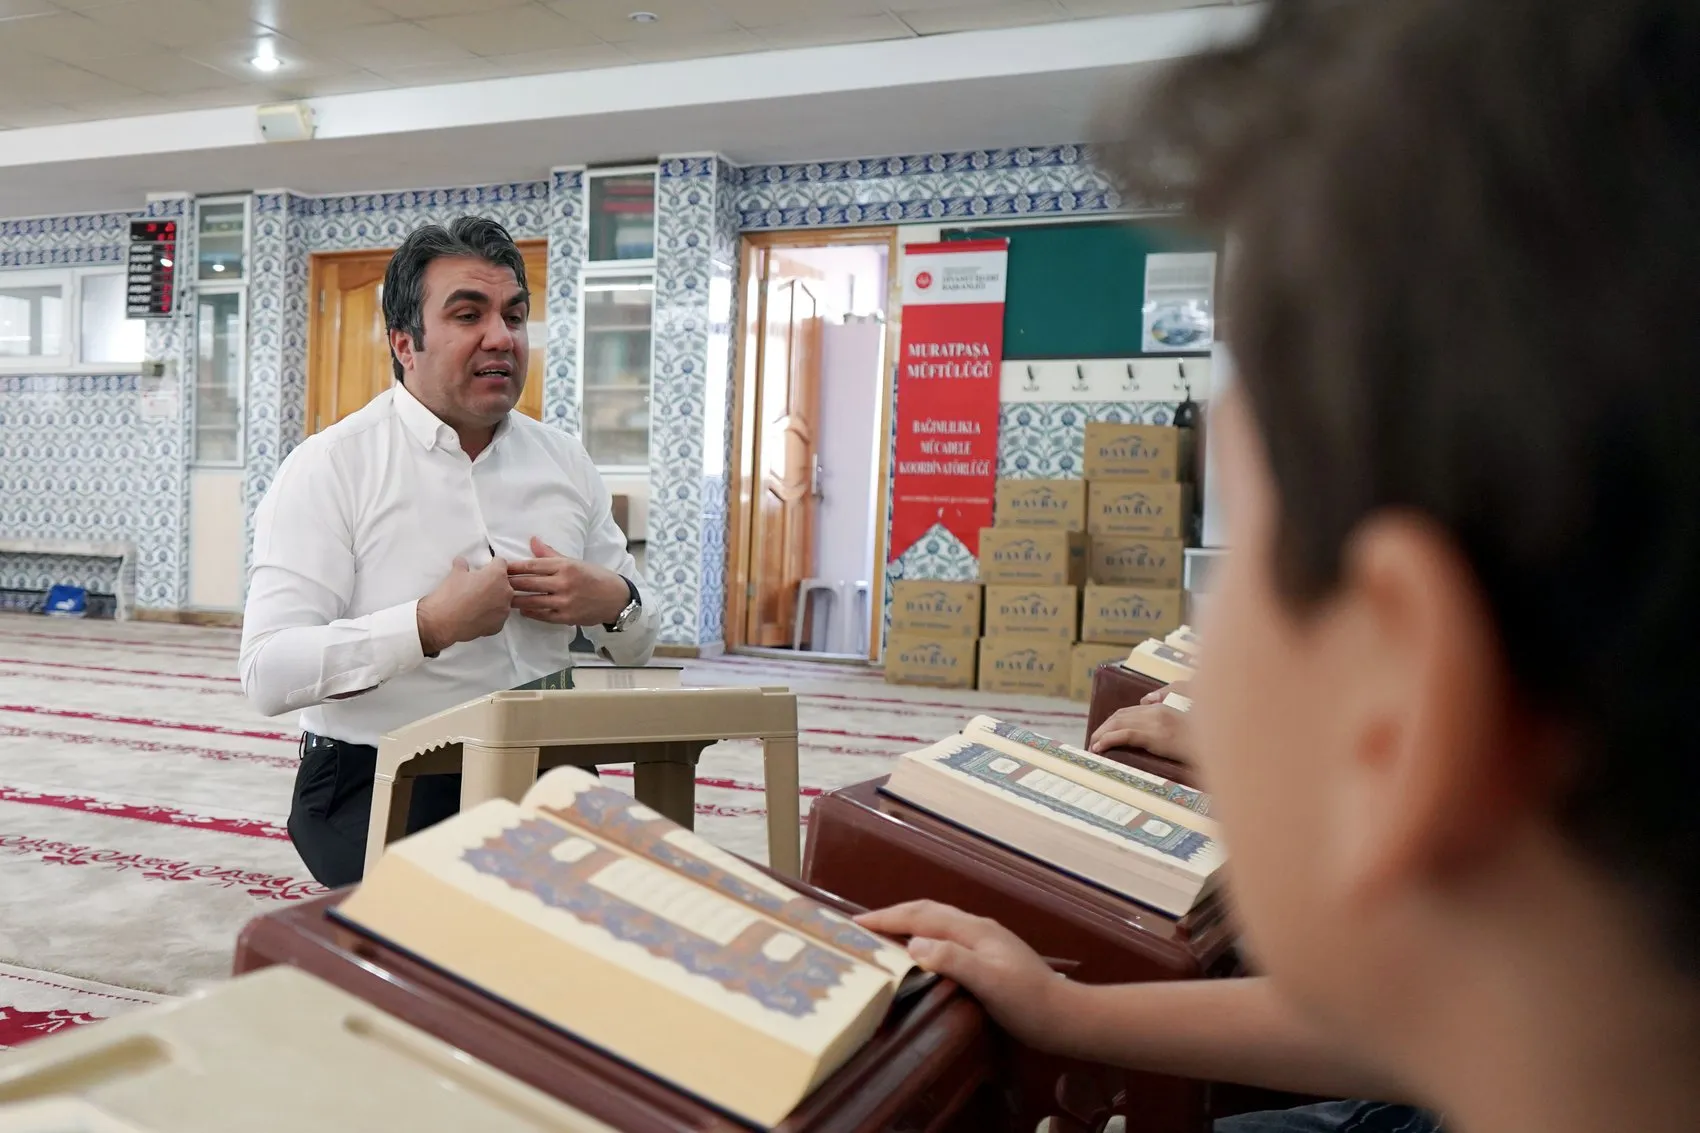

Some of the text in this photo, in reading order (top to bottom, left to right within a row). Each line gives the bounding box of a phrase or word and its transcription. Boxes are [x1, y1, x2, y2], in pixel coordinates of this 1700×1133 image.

[908, 342, 990, 359] MURATPAŞA
[907, 360, 993, 379] MÜFTÜLÜĞÜ
[920, 438, 972, 455] MÜCADELE
[899, 459, 991, 477] KOORDİNATÖRLÜĞÜ
